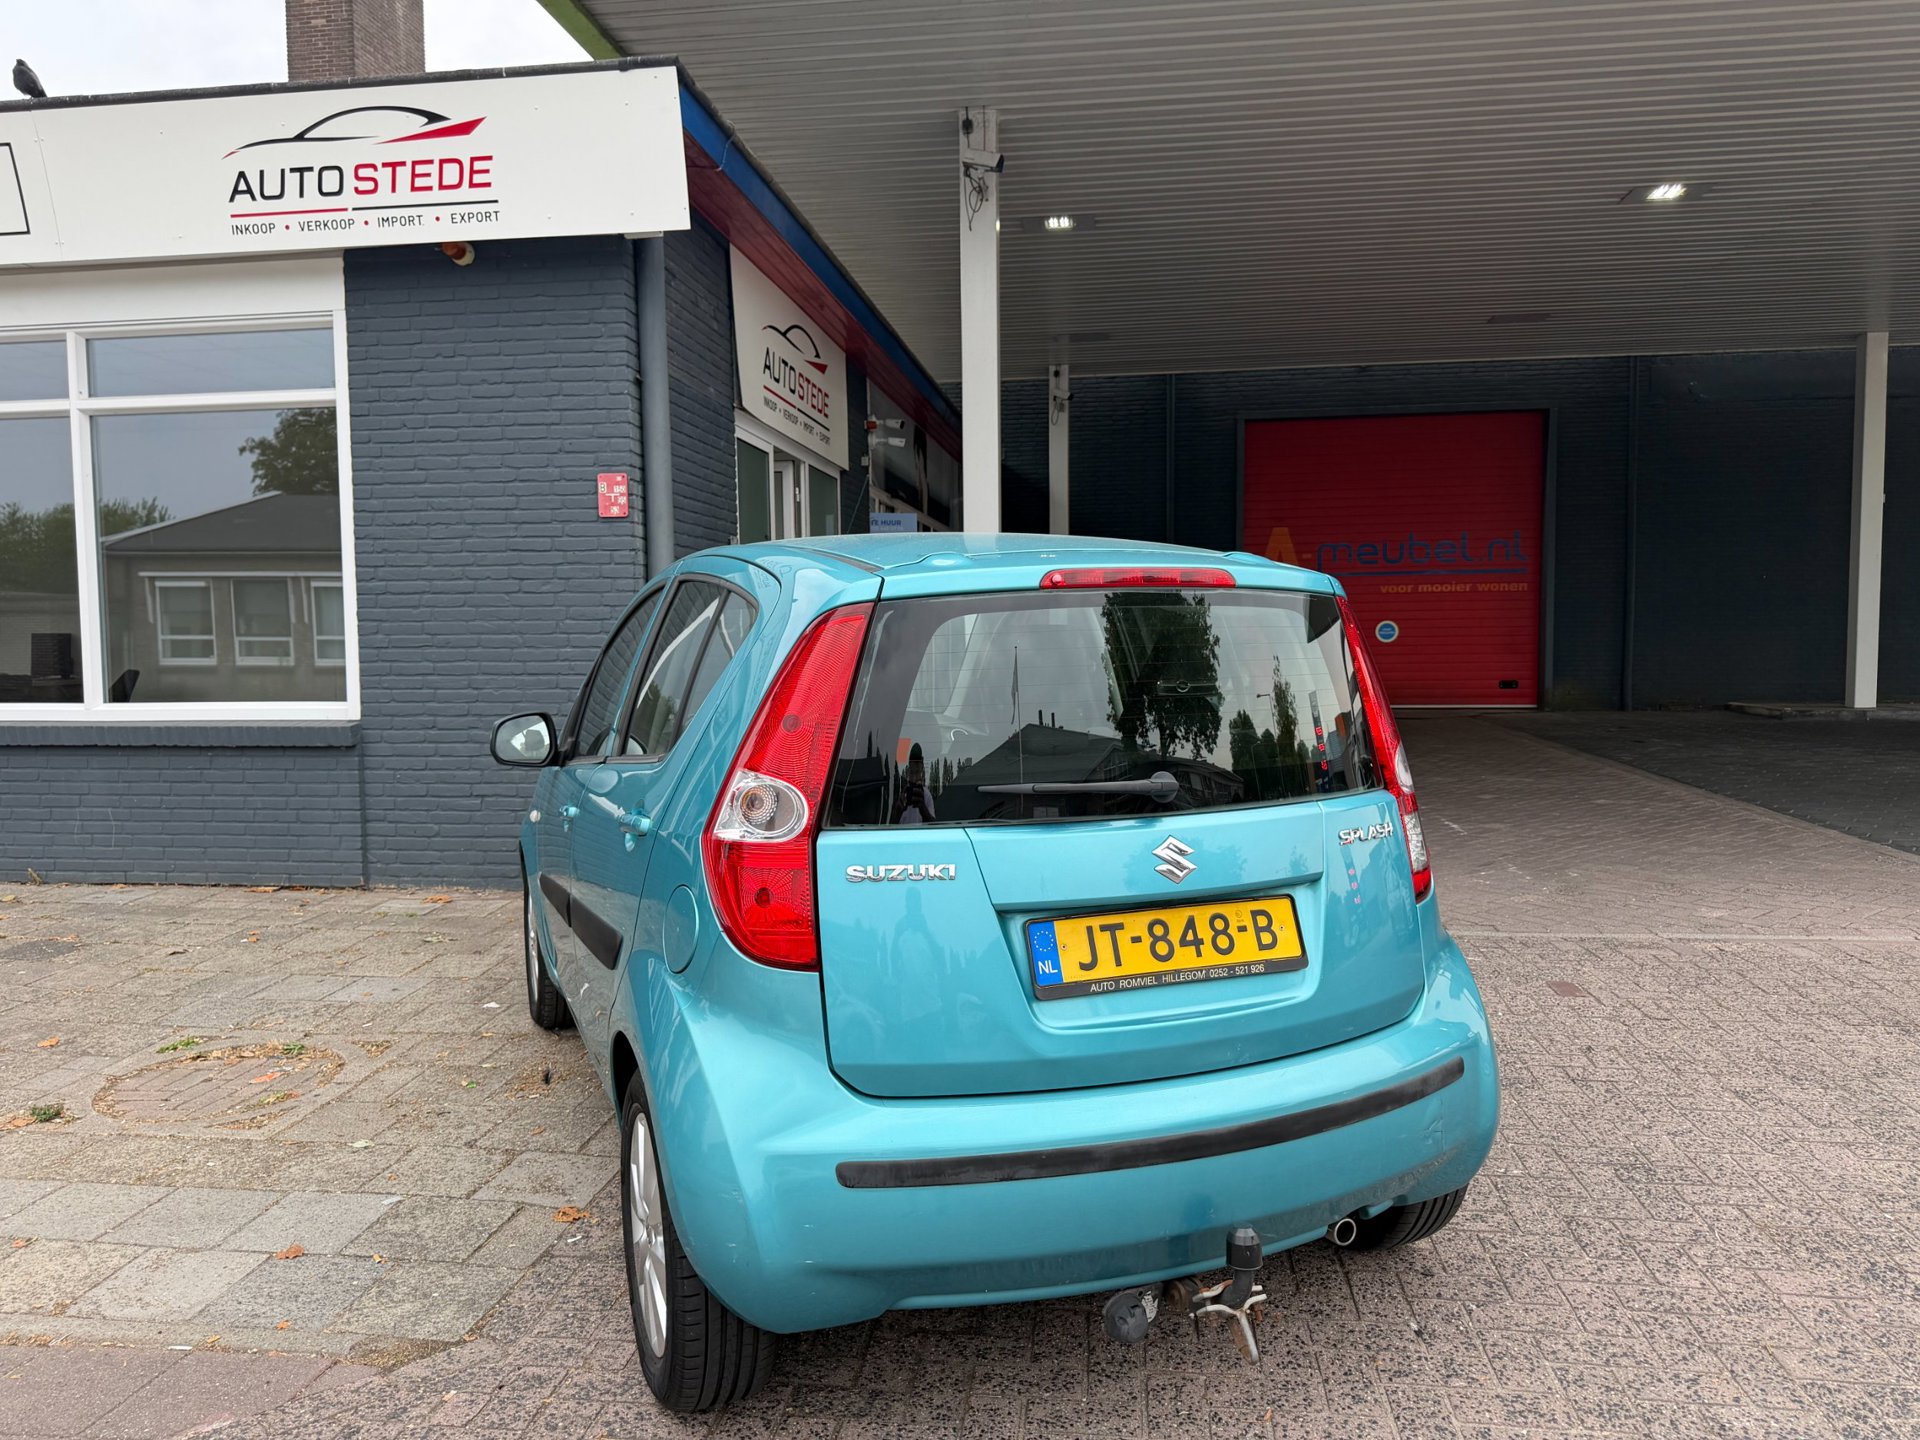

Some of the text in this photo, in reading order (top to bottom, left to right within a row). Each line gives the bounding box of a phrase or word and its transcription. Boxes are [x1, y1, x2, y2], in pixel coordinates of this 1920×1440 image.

[231, 210, 500, 236] INKOOP VERKOOP IMPORT EXPORT
[880, 519, 902, 527] HUUR
[1380, 581, 1529, 594] voor mooier wonen
[1338, 821, 1394, 846] SPLASH
[846, 863, 956, 883] SUZUKI
[1078, 908, 1278, 972] JT-848-B
[1038, 959, 1058, 975] NL
[1090, 981, 1115, 993] AUTO
[1162, 969, 1206, 984] HILLEGOM
[1209, 967, 1228, 978] 0252
[1235, 965, 1249, 976] 521
[1250, 963, 1265, 974] 926
